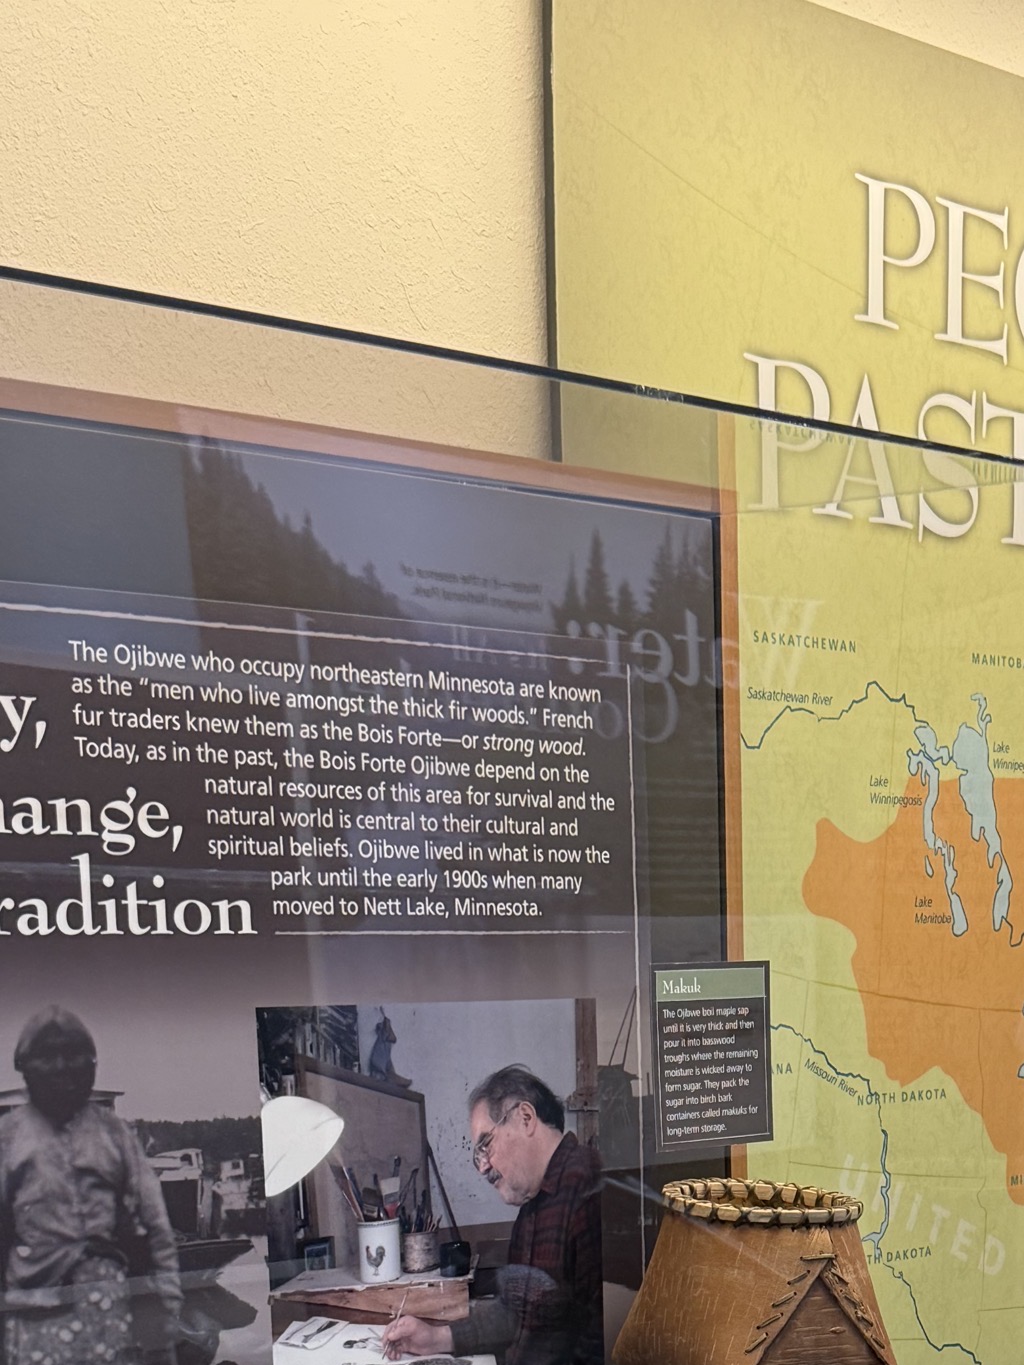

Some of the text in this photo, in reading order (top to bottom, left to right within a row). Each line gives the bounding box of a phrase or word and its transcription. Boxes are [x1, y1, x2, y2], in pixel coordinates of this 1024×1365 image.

[753, 630, 857, 653] SASKATCHEWAN
[69, 640, 601, 703] The Ojibwe who occupy northeastern Minnesota are known
[71, 676, 93, 694] as
[97, 675, 133, 697] the
[199, 683, 243, 704] who
[248, 685, 281, 707] live
[285, 692, 365, 717] amongst
[368, 694, 399, 716] the
[402, 697, 445, 719] thick
[448, 699, 468, 720] fir
[543, 708, 593, 730] French
[747, 686, 833, 706] Saskatchewan River
[72, 705, 104, 726] fur
[108, 708, 181, 731] traders
[186, 712, 240, 734] knew
[244, 716, 294, 738] them
[299, 723, 318, 740] as
[322, 721, 353, 742] the
[358, 722, 394, 744] Bois
[482, 733, 534, 758] strong
[538, 737, 586, 756] wood.
[992, 741, 1010, 754] Lake
[869, 775, 889, 788] Lake
[869, 792, 923, 808] Winnipegosis
[914, 896, 933, 908] Lake
[914, 912, 952, 924] Manitoba
[662, 977, 701, 995] Makuk
[804, 1058, 858, 1098] Missouri River
[857, 1088, 947, 1106] NORTH DAKOTA
[839, 1154, 1005, 1275] UNITED
